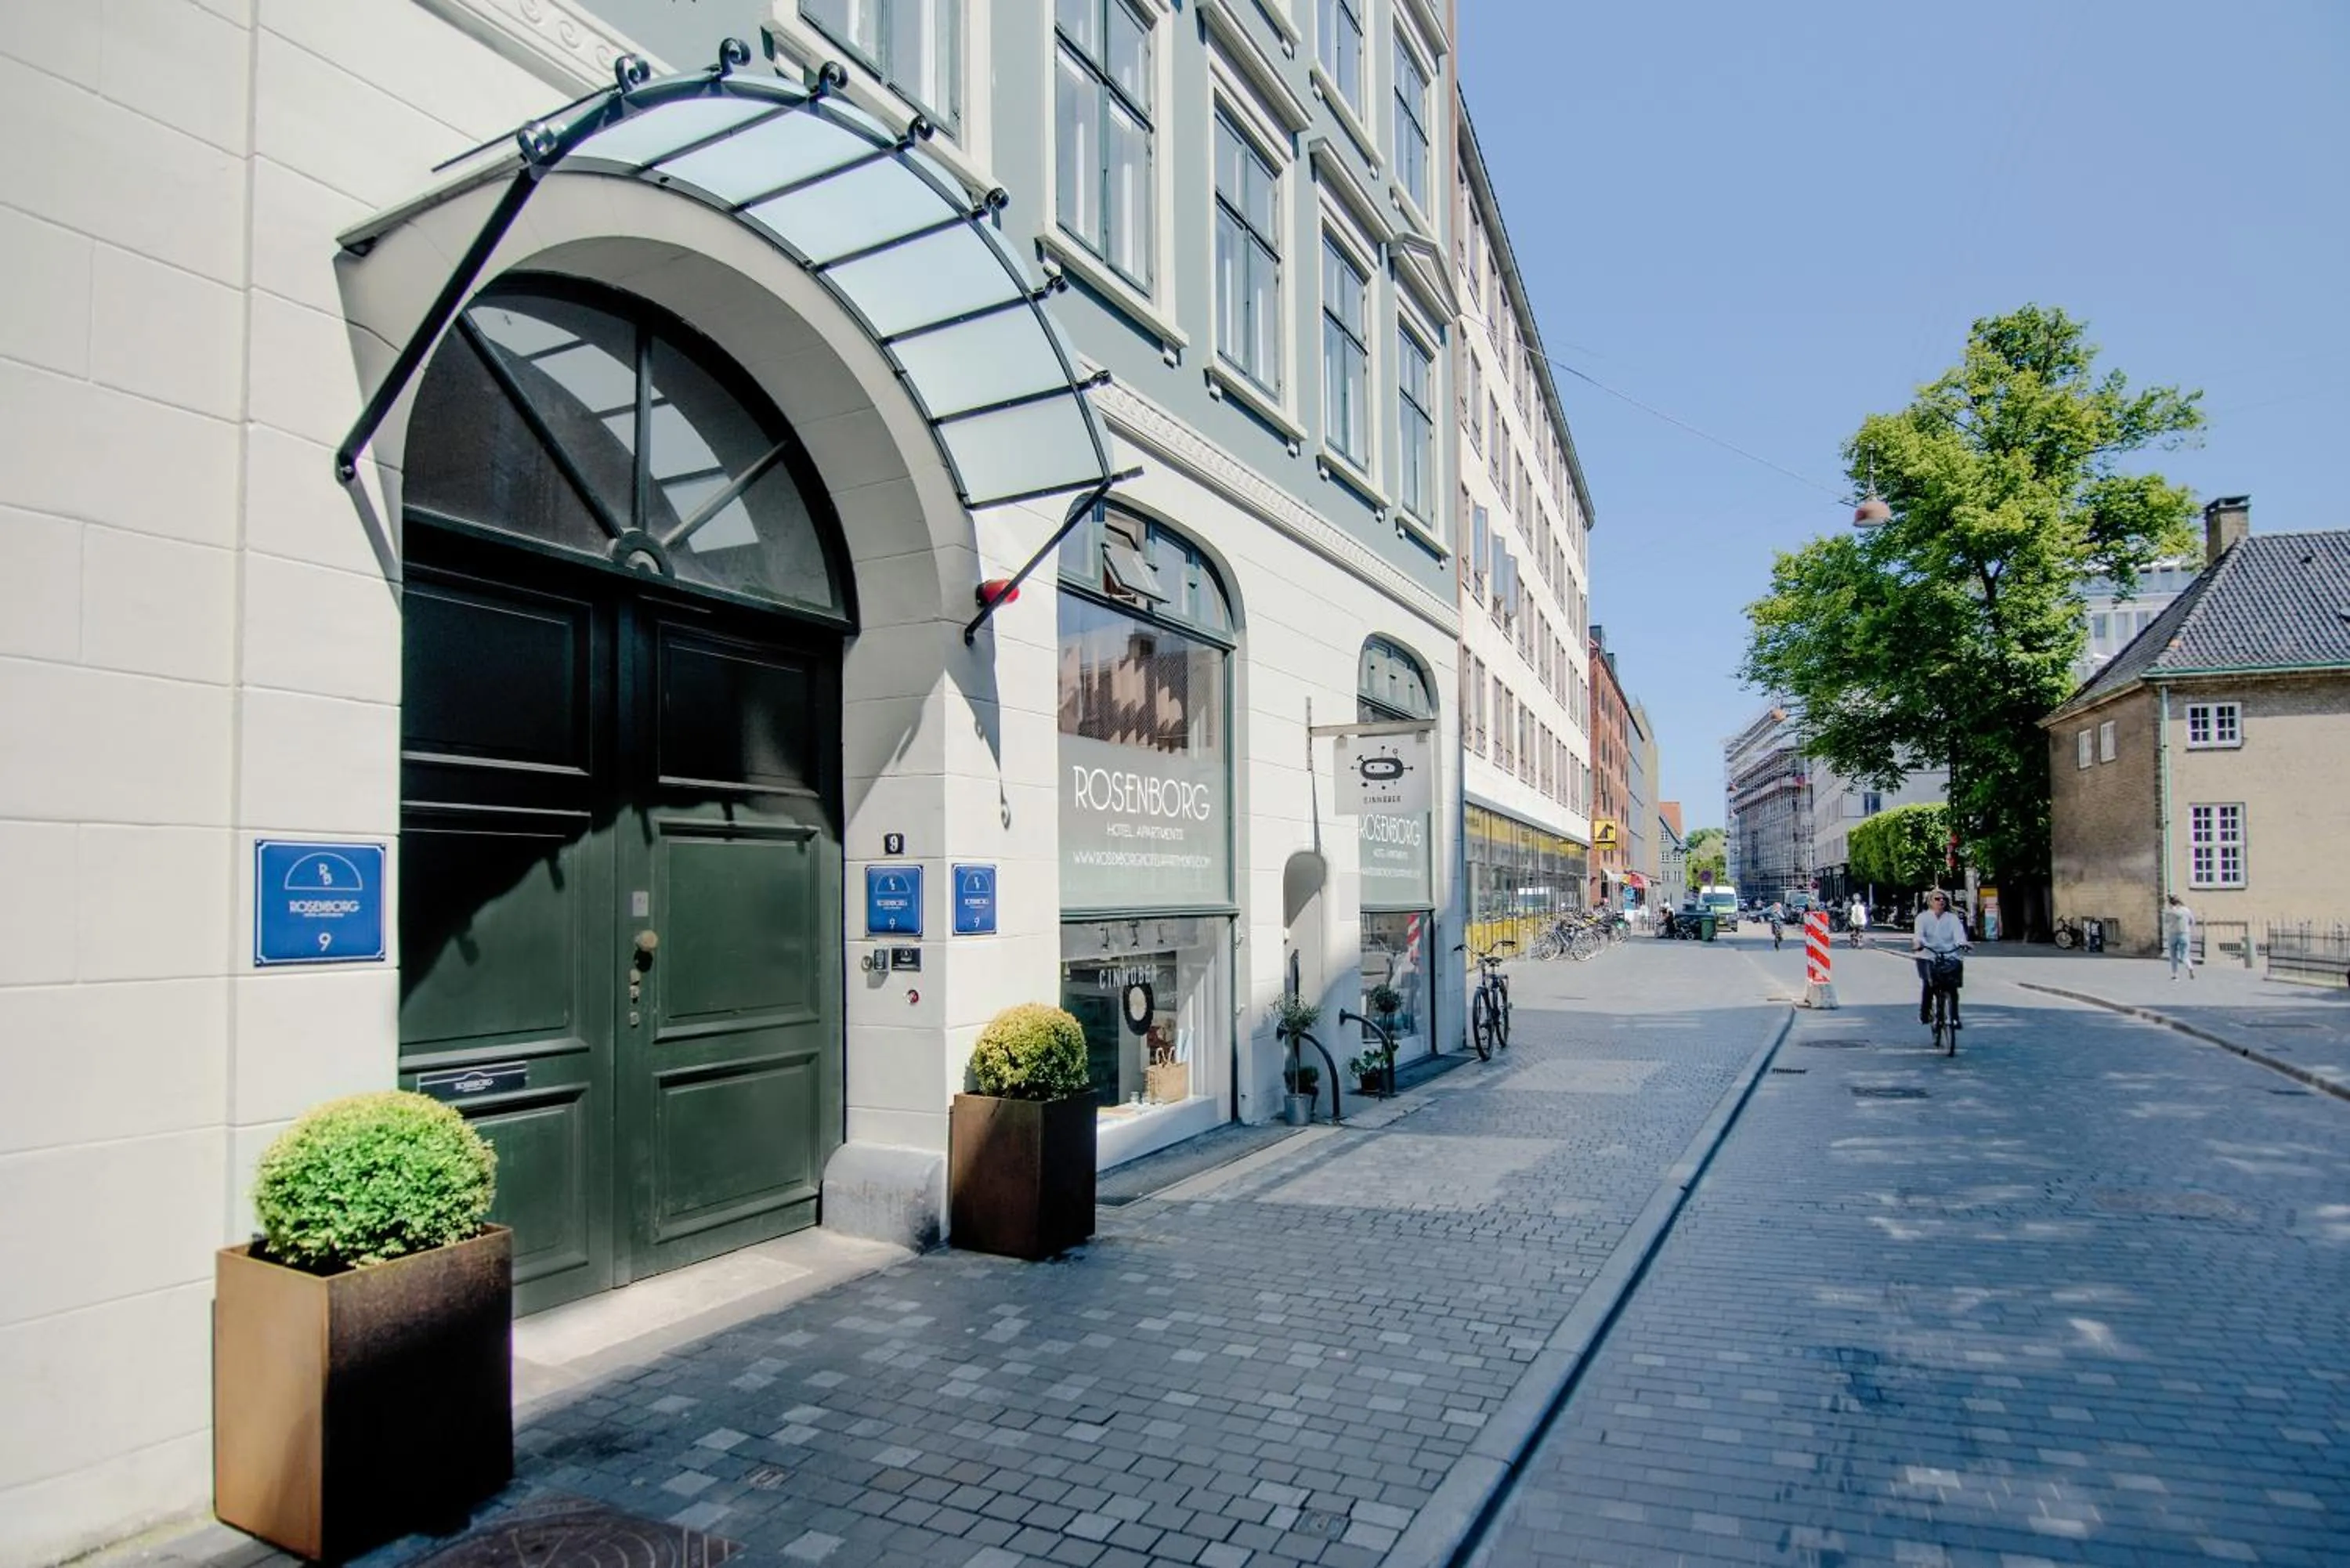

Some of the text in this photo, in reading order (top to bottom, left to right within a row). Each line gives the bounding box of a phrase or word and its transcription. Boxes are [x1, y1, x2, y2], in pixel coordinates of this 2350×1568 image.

[1073, 765, 1210, 821] ROSENBORG
[889, 835, 898, 852] 9
[889, 917, 896, 930] 9
[974, 916, 980, 928] 9
[318, 932, 332, 952] 9
[1099, 964, 1158, 990] CINNOBER
